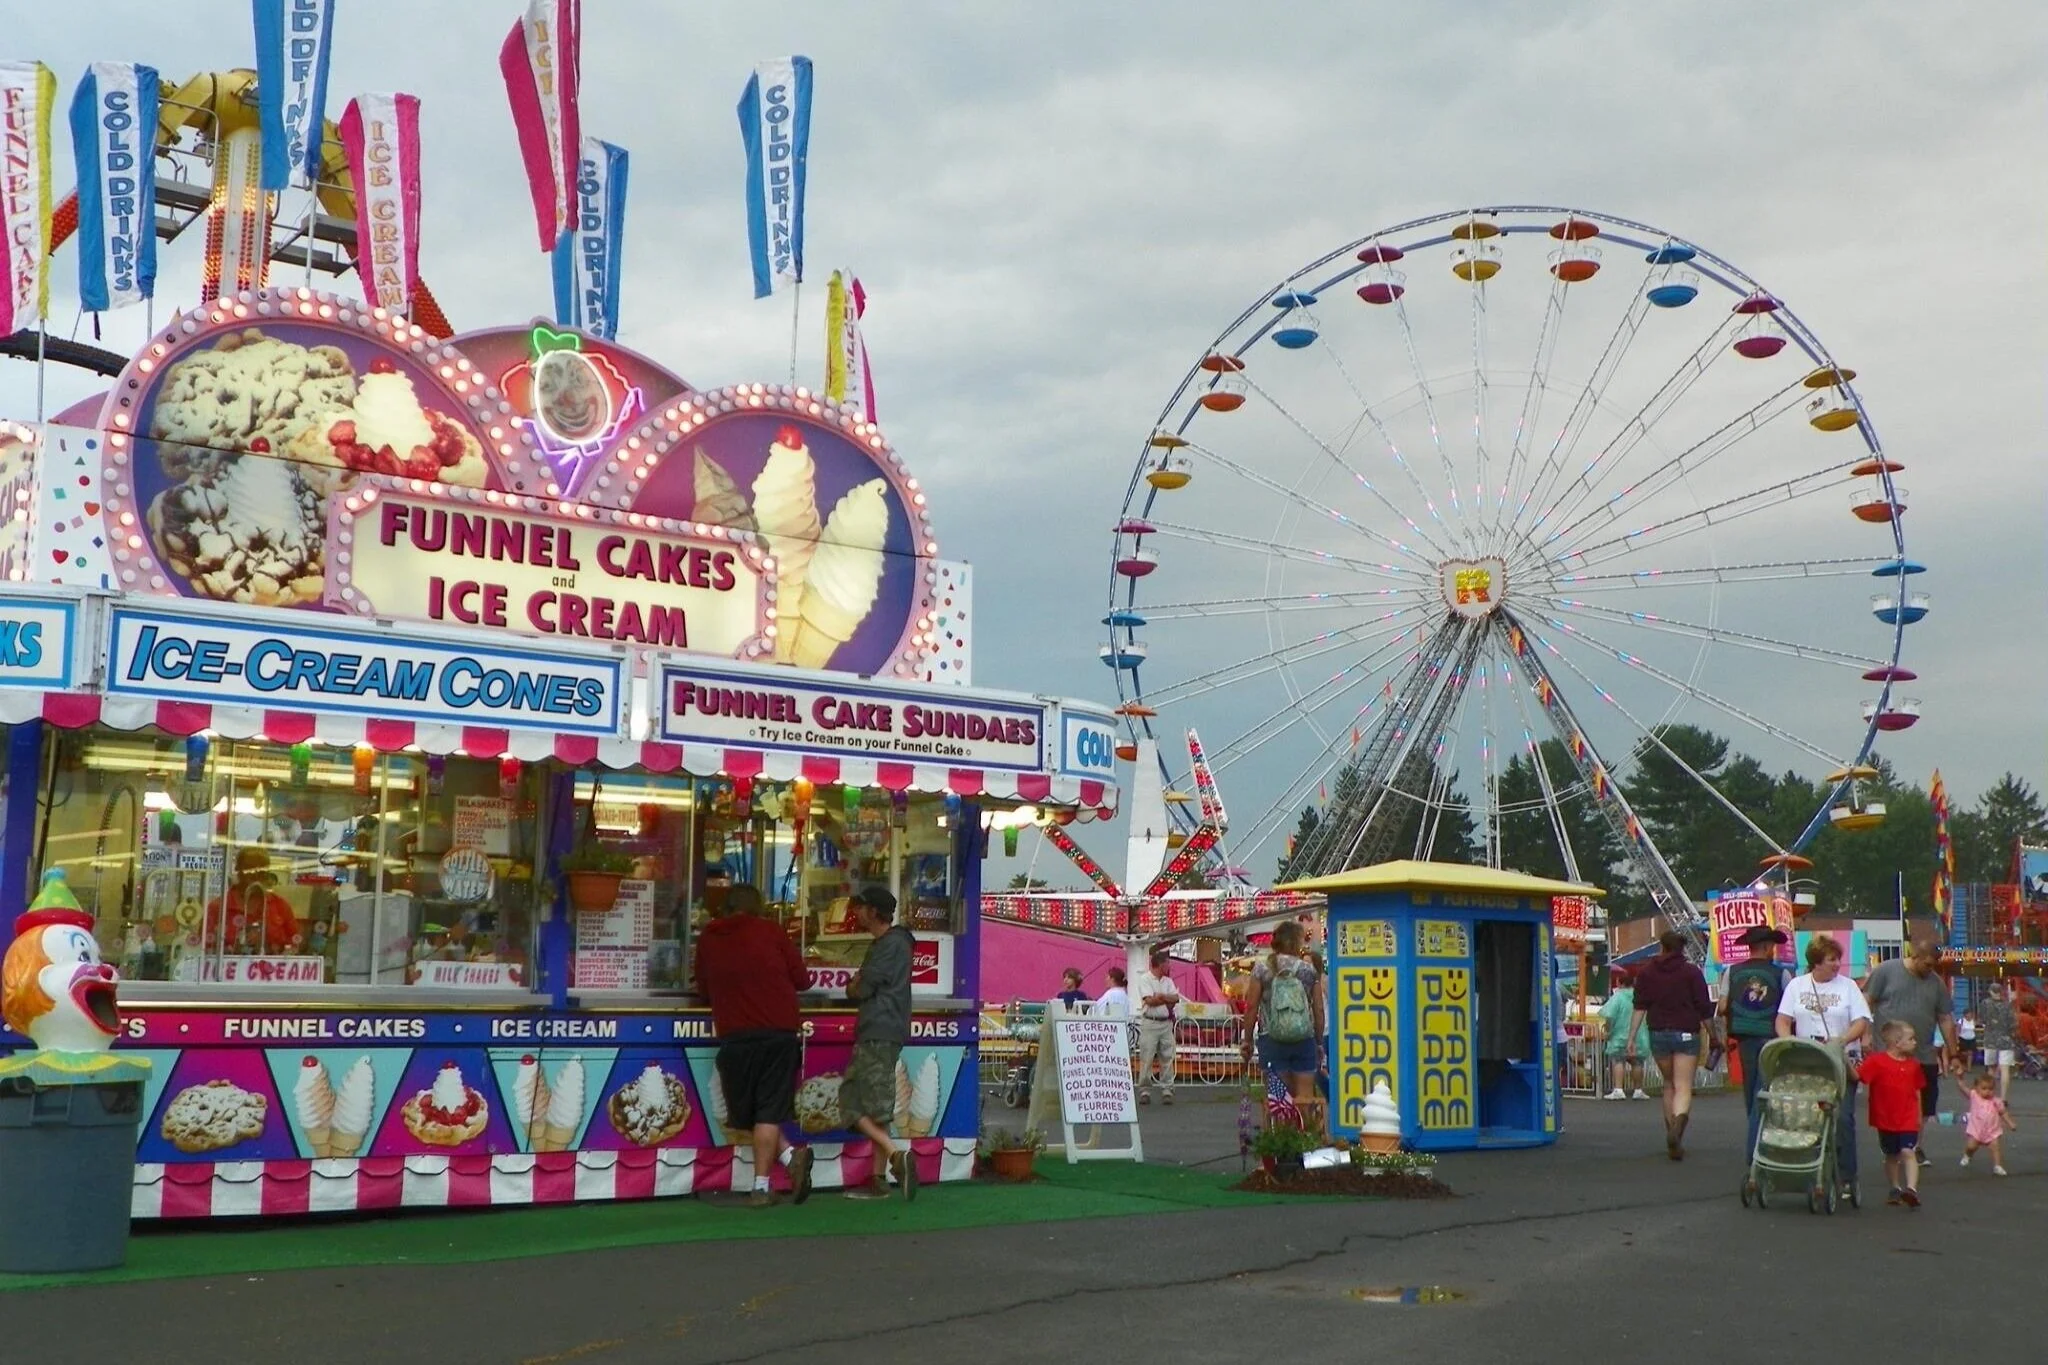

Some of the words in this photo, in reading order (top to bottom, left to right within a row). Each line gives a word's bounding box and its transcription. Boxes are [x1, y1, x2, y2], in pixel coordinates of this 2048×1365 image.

[103, 91, 135, 173] COLD
[764, 84, 791, 163] COLD
[4, 86, 30, 215] FUNNEL
[368, 121, 393, 187] ICE
[577, 159, 601, 231] COLD
[108, 177, 137, 292] DRINKS
[770, 166, 791, 276] DRINKS
[371, 200, 403, 314] CREAM
[380, 502, 581, 571] FUNNEL
[595, 534, 737, 592] CAKES
[551, 572, 576, 589] and
[428, 576, 508, 627] ICE
[526, 590, 688, 648] CREAM
[127, 625, 435, 702] ICE-CREAM
[437, 657, 605, 717] CONES
[672, 680, 802, 724] FUNNEL
[812, 696, 892, 733] CAKE
[903, 704, 1037, 746] SUNDAES
[759, 726, 780, 743] Try
[783, 728, 802, 741] Ice
[805, 731, 845, 745] Cream
[847, 736, 863, 747] on
[865, 738, 892, 752] your
[894, 740, 932, 754] Funnel
[935, 743, 964, 757] Cake
[1077, 727, 1113, 769] COLD
[1714, 900, 1768, 930] TICKETS
[247, 960, 319, 982] CREAM
[433, 964, 459, 984] MILK
[224, 1018, 333, 1038] FUNNEL
[338, 1018, 425, 1038] CAKES
[492, 1019, 531, 1037] ICE
[535, 1019, 617, 1038] CREAM
[1066, 1023, 1081, 1033] ICE
[1084, 1023, 1118, 1033] CREAM
[1071, 1033, 1116, 1044] SUNDAYS
[1062, 1056, 1097, 1067] FUNNEL
[1098, 1055, 1128, 1067] CAKES
[1076, 1044, 1111, 1053] CANDY
[1421, 974, 1445, 1126] PLACE
[1063, 1068, 1085, 1079] FUNNEL
[1086, 1067, 1103, 1076] CAKE
[1446, 1005, 1468, 1125] FACE
[1066, 1079, 1092, 1091] COLD
[1094, 1079, 1131, 1091] DRINKS
[1070, 1091, 1091, 1101] MILK
[1094, 1090, 1129, 1101] SHAKES
[1078, 1102, 1124, 1112] FLURRIES
[1084, 1112, 1120, 1122] FLOATS
